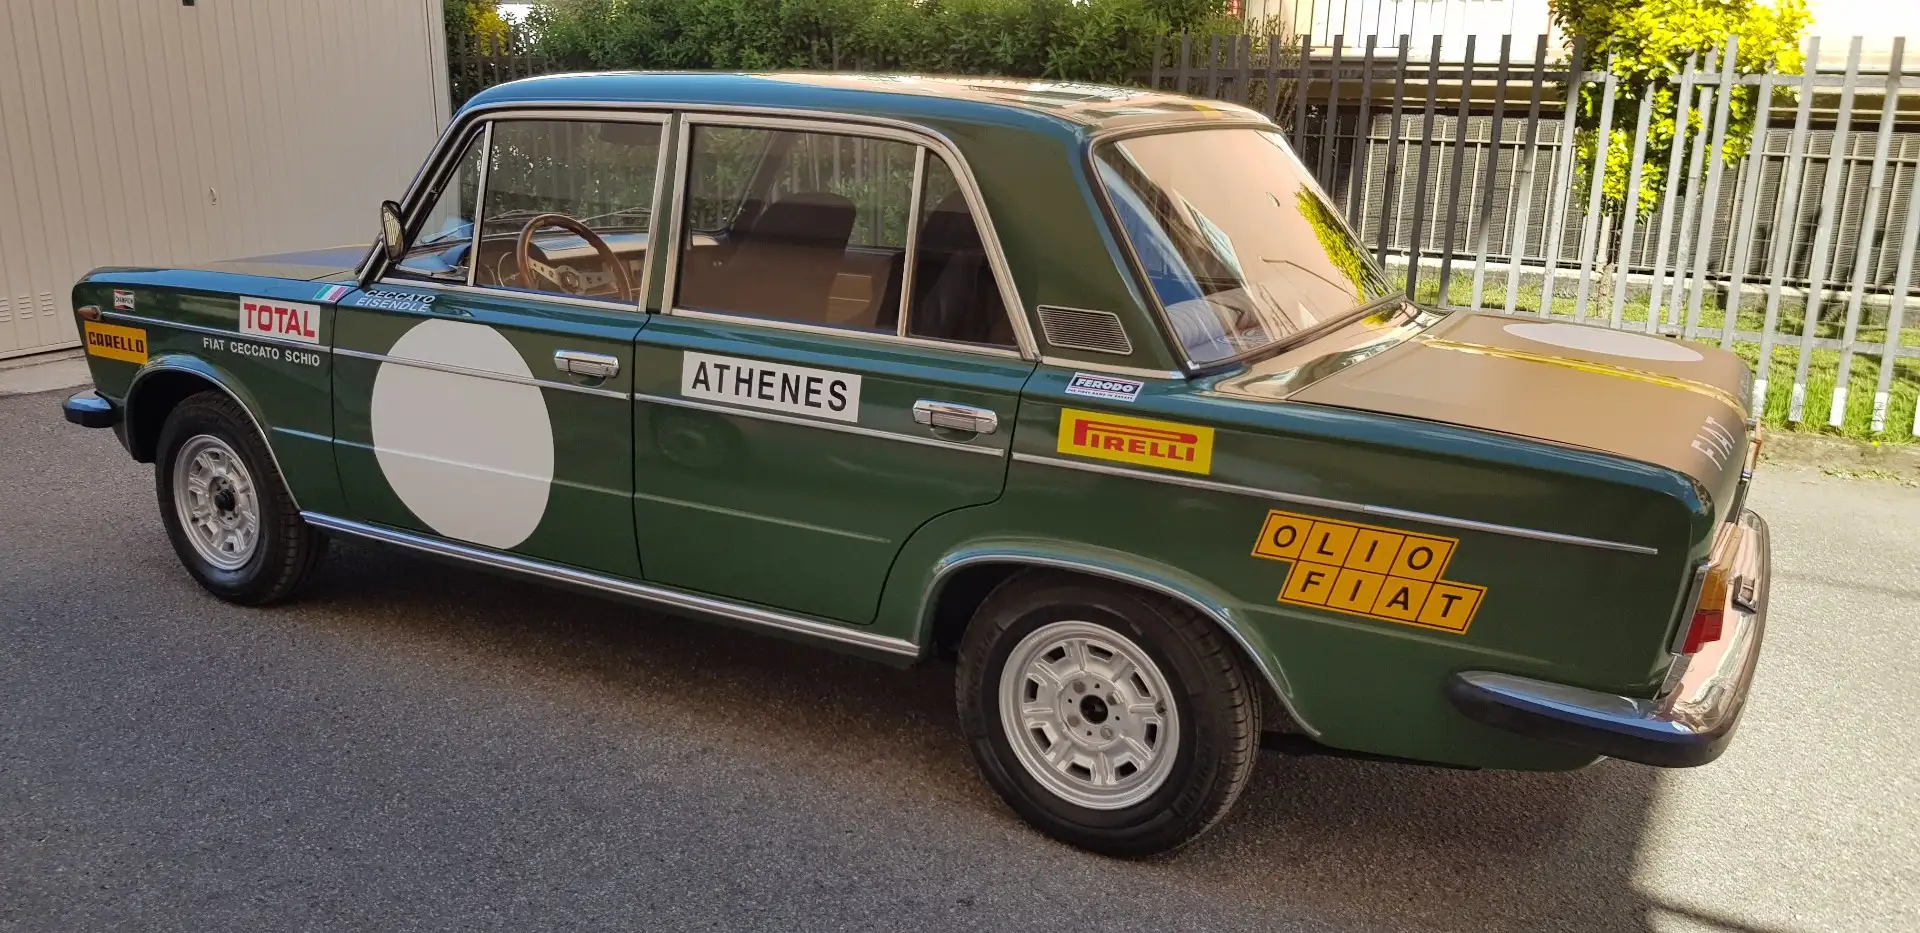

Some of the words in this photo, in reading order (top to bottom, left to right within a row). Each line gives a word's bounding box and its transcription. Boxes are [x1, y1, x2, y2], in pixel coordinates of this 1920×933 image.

[356, 297, 431, 312] EISENDLE
[365, 290, 435, 304] CECCATO
[243, 303, 316, 338] TOTAL
[89, 331, 145, 354] CARELLO
[203, 337, 224, 351] FIAT
[230, 342, 280, 359] CECCATO
[285, 350, 320, 367] SCHIO
[691, 361, 848, 412] ATHENES
[1075, 378, 1134, 392] FERODO
[1073, 418, 1198, 462] PIRELLI
[1690, 415, 1736, 471] FIAT
[1272, 525, 1434, 571] OLIO
[1300, 570, 1464, 618] FIAT
